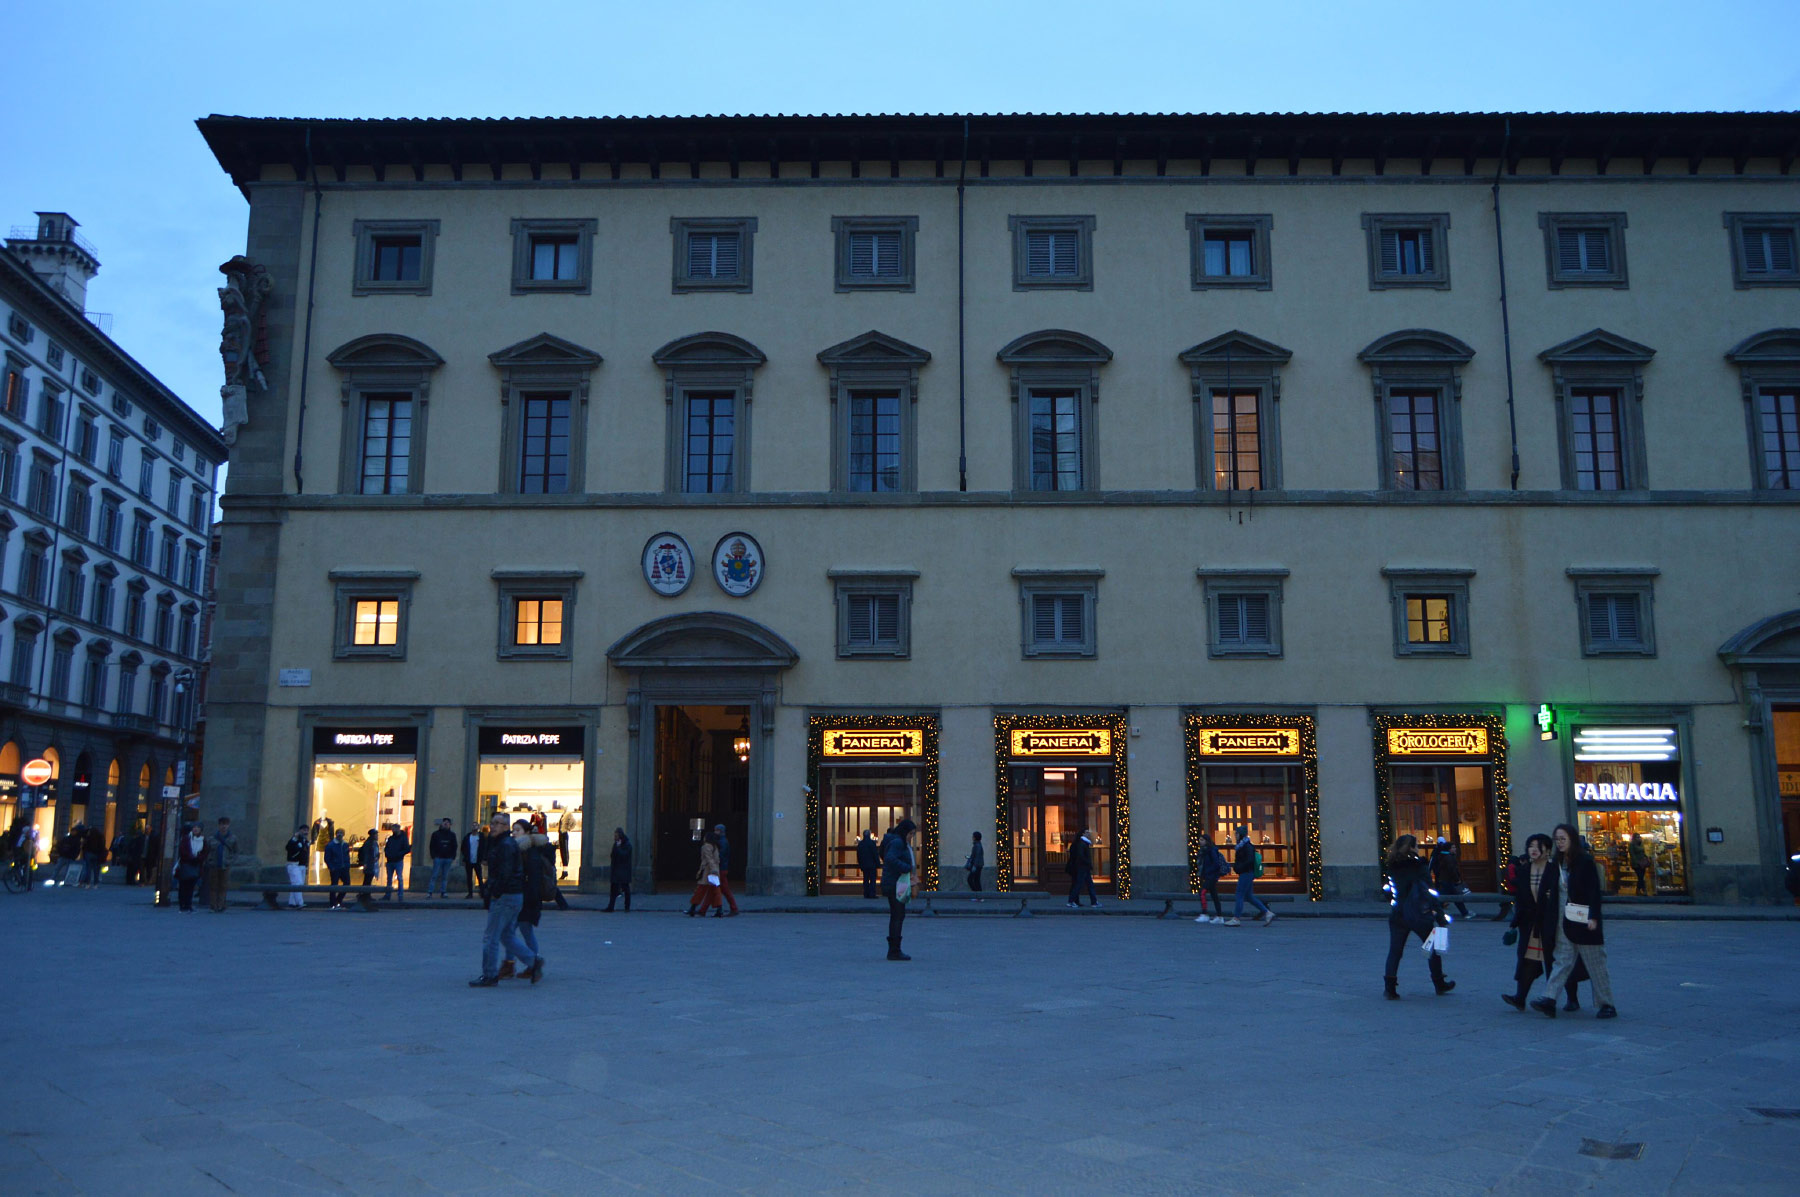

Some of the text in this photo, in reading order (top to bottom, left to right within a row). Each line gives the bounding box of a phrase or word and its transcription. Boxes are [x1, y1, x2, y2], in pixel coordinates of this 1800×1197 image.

[335, 733, 394, 745] PATRIZIA PEPE
[502, 733, 560, 745] PATRIZIA PEPE
[841, 738, 905, 748] PANERAI
[1029, 737, 1093, 747] PANERAI
[1217, 737, 1281, 747] PANERAI
[1399, 735, 1476, 748] OROLOGERIA
[1574, 782, 1676, 801] FARMACIA
